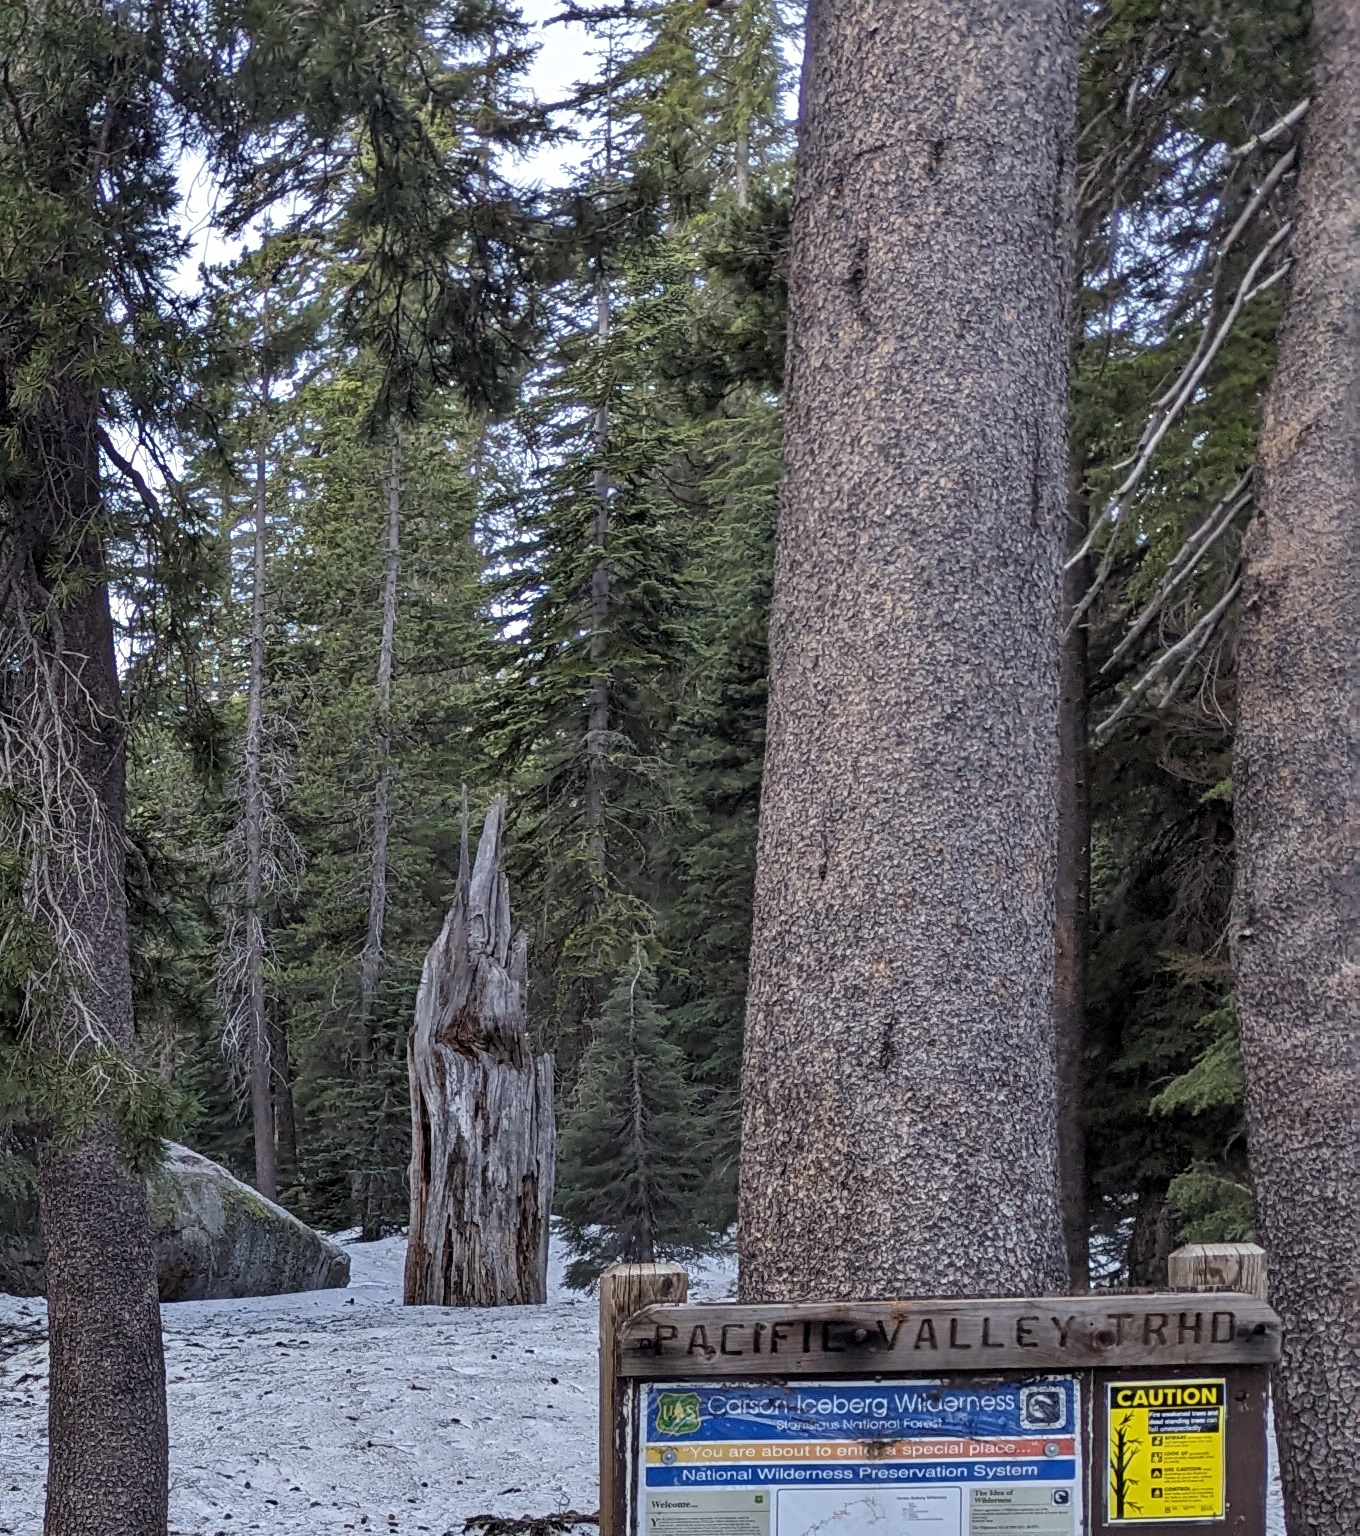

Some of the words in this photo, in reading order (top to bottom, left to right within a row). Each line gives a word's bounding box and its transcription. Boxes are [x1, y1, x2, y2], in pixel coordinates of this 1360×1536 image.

[654, 1319, 847, 1356] PACIFIC
[877, 1315, 1076, 1351] VALLEY
[1107, 1311, 1236, 1347] TRHD
[894, 1393, 1016, 1412] Wilderness
[1117, 1387, 1217, 1406] CAUTION
[842, 1418, 900, 1431] National
[903, 1417, 943, 1429] Forest
[729, 1448, 755, 1458] are
[761, 1445, 812, 1457] about
[816, 1445, 831, 1457] to
[885, 1446, 897, 1456] a
[902, 1442, 964, 1457] special
[682, 1468, 752, 1481] National
[757, 1466, 853, 1480] Wilderness
[859, 1465, 968, 1479] Preservation
[973, 1464, 1038, 1480] System
